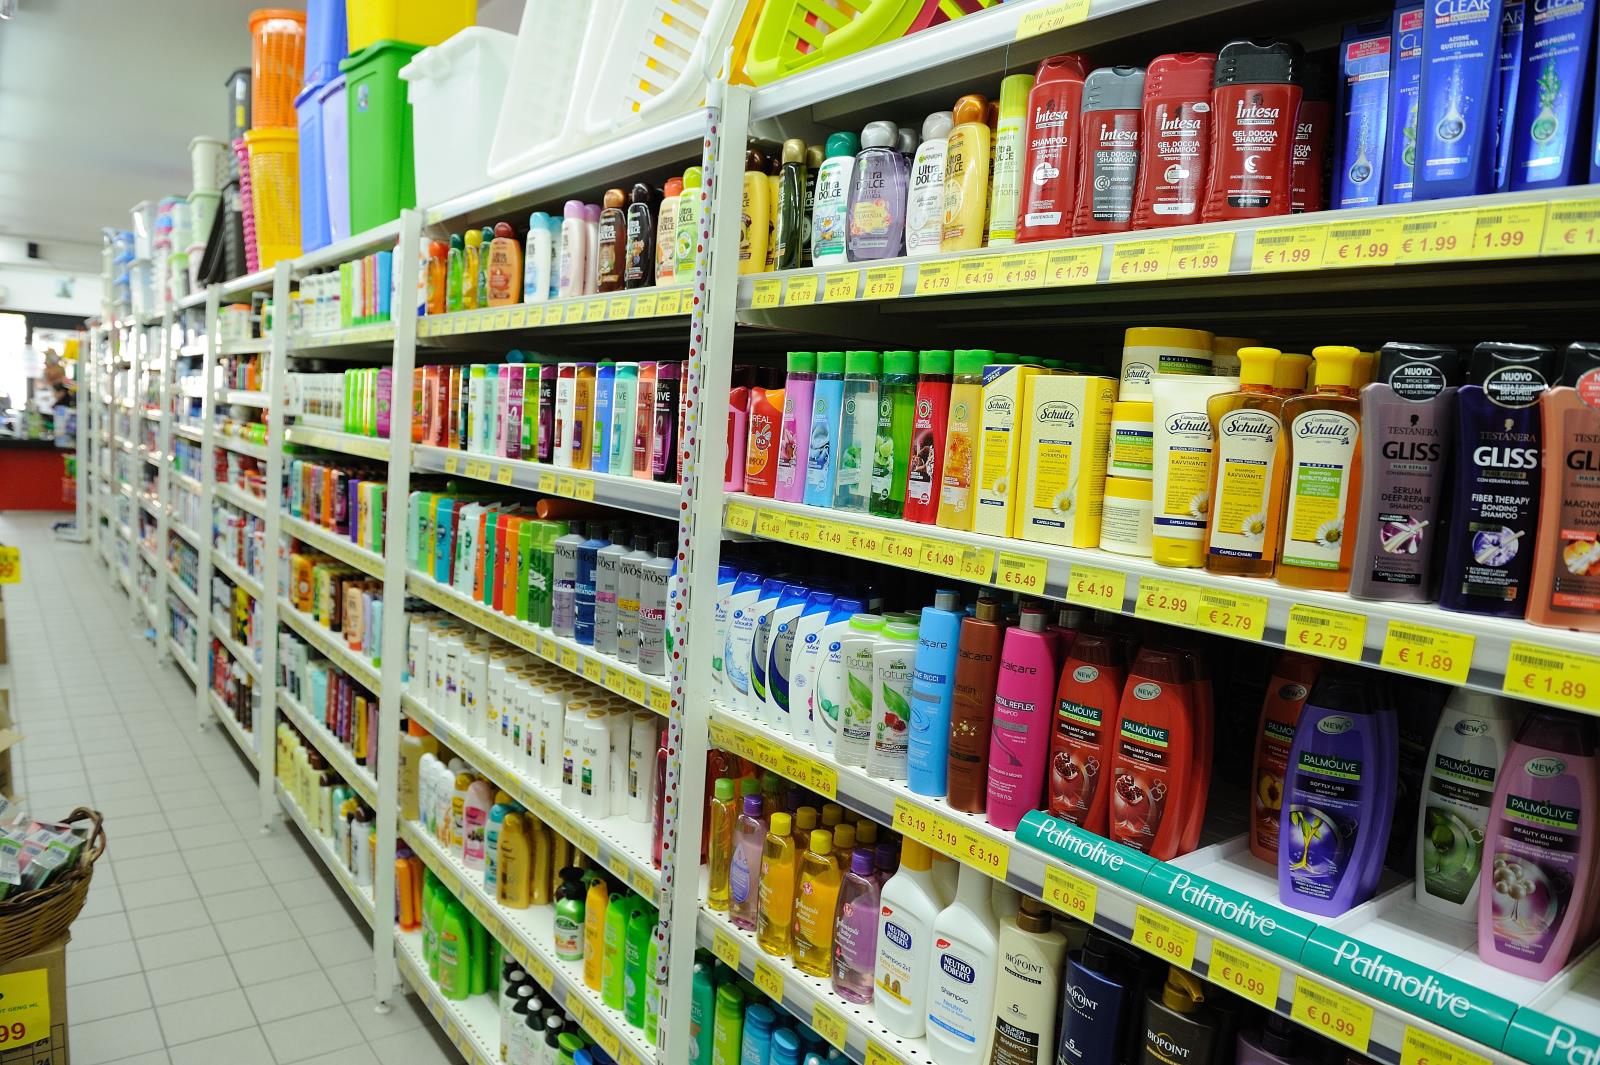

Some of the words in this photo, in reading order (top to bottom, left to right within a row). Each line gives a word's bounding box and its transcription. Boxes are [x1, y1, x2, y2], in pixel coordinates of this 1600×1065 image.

[1434, 0, 1490, 17] CLEAR
[1031, 136, 1068, 147] SHAMPOO
[1234, 136, 1275, 144] SHAMPOO
[1248, 130, 1278, 138] DOCCIA
[1160, 146, 1197, 154] SHAMPOO
[1172, 140, 1200, 148] DOCCIA
[918, 164, 938, 177] Ultra
[916, 172, 944, 186] DOLCE
[1483, 230, 1525, 248] 1.99
[1563, 228, 1577, 244] €
[1338, 244, 1349, 259] €
[1353, 243, 1389, 258] 1.99
[1401, 238, 1412, 253] €
[1418, 235, 1457, 252] 1.99
[1177, 258, 1187, 270] €
[1189, 255, 1219, 269] 1.99
[1263, 250, 1274, 264] €
[1278, 248, 1311, 263] 1.99
[1055, 269, 1063, 279] €
[1066, 266, 1089, 279] 1.79
[1120, 263, 1130, 274] €
[1132, 259, 1158, 274] 1.99
[932, 277, 950, 289] 1.79
[973, 272, 993, 284] 4.19
[1006, 272, 1014, 282] €
[1015, 270, 1037, 282] 1.99
[878, 283, 894, 293] 1.79
[1125, 369, 1151, 379] Schultz
[1404, 368, 1433, 376] NUOVO
[1500, 372, 1532, 382] NUOVO
[987, 400, 1011, 410] Schultz
[1040, 408, 1075, 420] Schultz
[1227, 420, 1274, 435] Schultz
[1300, 422, 1350, 436] Schultz
[1387, 426, 1440, 436] TESTANERA
[1480, 431, 1536, 443] TESTANERA
[1382, 441, 1441, 461] GLISS
[1473, 446, 1538, 469] GLISS
[1227, 472, 1263, 480] RAVVIVANTE
[1393, 486, 1422, 495] SERUM
[1381, 493, 1432, 504] DEEP-REPAIR
[1471, 494, 1492, 503] FIBER
[1494, 495, 1530, 506] THERAPY
[1389, 502, 1423, 511] SHAMPOO
[1481, 504, 1518, 513] BONDING
[1480, 510, 1518, 520] SHAMPOO
[825, 531, 841, 543] 1.49
[851, 537, 857, 547] €
[858, 538, 876, 551] 1.49
[887, 543, 894, 554] €
[895, 545, 913, 558] 1.49
[926, 550, 933, 561] €
[935, 552, 954, 565] 1.49
[966, 562, 986, 575] 5.49
[1005, 571, 1012, 583] €
[1014, 571, 1036, 587] 5.49
[1077, 579, 1085, 591] €
[1086, 581, 1114, 599] 4.19
[1146, 593, 1155, 606] €
[1158, 595, 1188, 612] 2.99
[1209, 609, 1218, 623] €
[1220, 610, 1252, 630] 2.79
[1299, 629, 1309, 643] €
[1312, 630, 1348, 651] 2.79
[1398, 647, 1409, 663] €
[1415, 650, 1453, 672] 1.89
[1076, 671, 1092, 679] NEW
[1137, 687, 1153, 696] NEW
[1523, 672, 1535, 689] €
[1543, 675, 1587, 700] 1.89
[1010, 700, 1035, 712] REFLEX
[1062, 702, 1099, 719] PALMOLIVE
[1124, 721, 1165, 740] PALMOLIVE
[1323, 721, 1344, 731] NEW
[1459, 723, 1479, 733] NEW
[1123, 744, 1145, 755] BRILLIANT
[1145, 751, 1162, 759] COLOR
[1303, 754, 1357, 773] PALMOLIVE
[1439, 757, 1490, 778] PALMOLIVE
[1530, 761, 1554, 774] NEW
[1309, 780, 1331, 789] SOFTLY
[1441, 784, 1457, 792] LONG
[1462, 789, 1480, 798] SHINE
[1511, 799, 1575, 821] PALMOLIVE
[899, 811, 906, 824] €
[908, 814, 926, 832] 3.19
[937, 829, 957, 846] 3.19
[1513, 826, 1539, 837] BEAUTY
[1540, 831, 1564, 843] GLOSS
[1524, 836, 1550, 847] SHAMPOO
[1035, 817, 1124, 873] Palmolive
[969, 844, 976, 857] €
[978, 848, 1000, 867] 3.19
[1053, 888, 1060, 900] €
[1063, 893, 1086, 912] 0.99
[1167, 872, 1278, 937] Palmolive
[887, 923, 909, 941] NEUTRO
[886, 932, 908, 949] ROBERTS
[1144, 931, 1152, 944] €
[1156, 935, 1183, 958] 0.99
[881, 949, 902, 967] Shampoo
[944, 956, 971, 975] NEUTRO
[1005, 952, 1044, 974] BIOPOINT
[943, 963, 971, 983] ROBERTS
[1332, 939, 1472, 1019] Palmolive
[1222, 967, 1231, 982] €
[1234, 971, 1265, 997] 0.99
[940, 986, 969, 1005] Shampoo
[1012, 1004, 1019, 1013] 5
[1307, 1004, 1317, 1020] €
[1321, 1008, 1356, 1037] 0.99
[999, 1025, 1032, 1044] NUTRIENTE
[1005, 1023, 1025, 1037] SUPER
[1000, 1036, 1028, 1054] SHAMPOO
[1146, 1028, 1190, 1059] BIOPOINT
